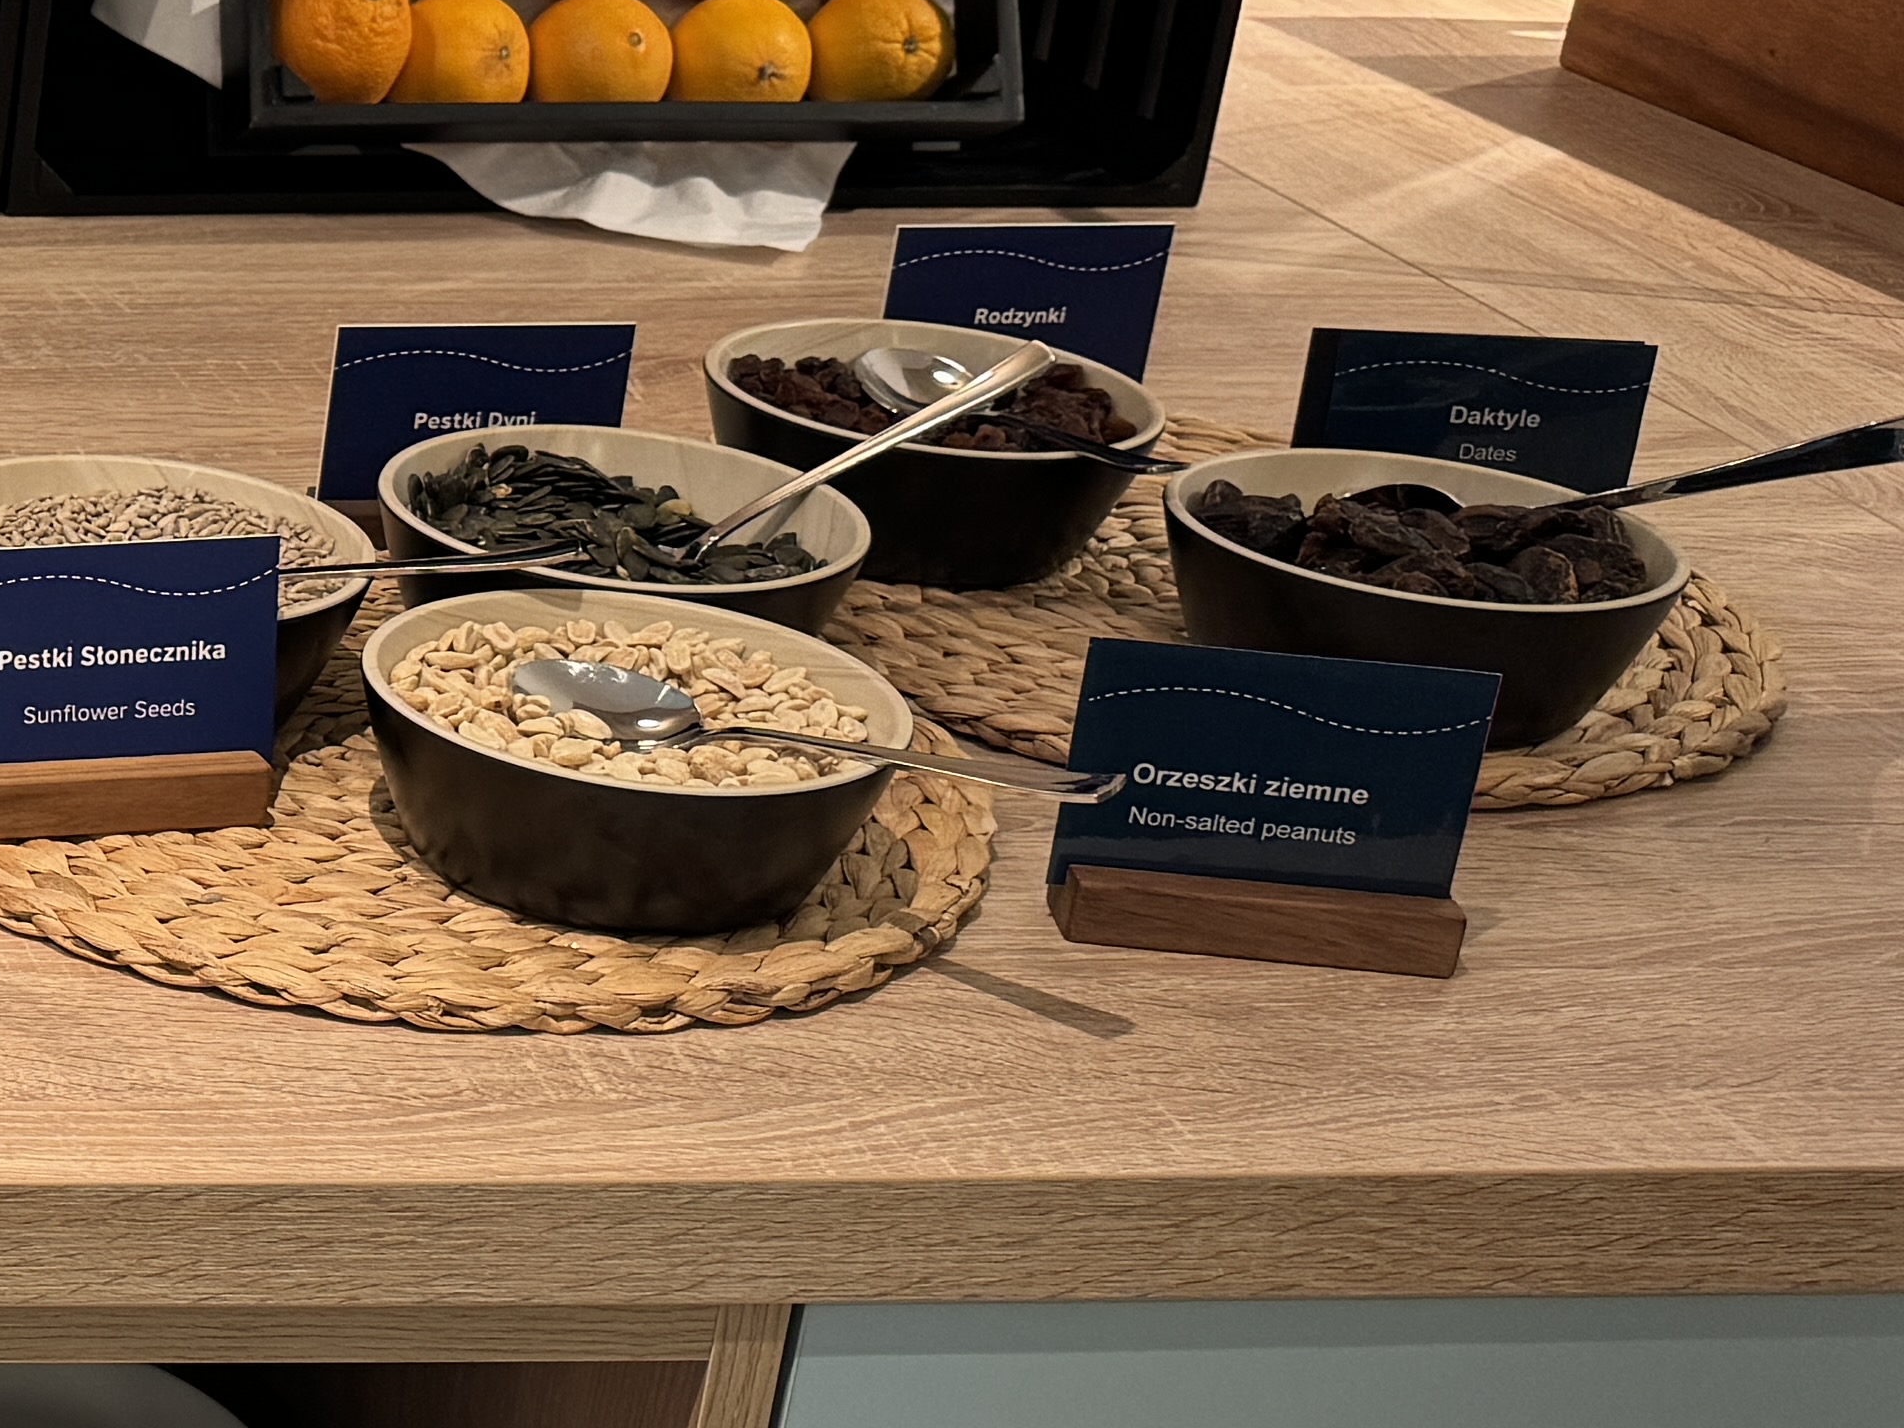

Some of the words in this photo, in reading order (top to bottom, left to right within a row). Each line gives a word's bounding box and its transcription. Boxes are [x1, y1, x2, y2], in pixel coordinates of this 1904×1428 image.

[974, 306, 1068, 328] Rodzynki
[413, 411, 482, 430] Pestki
[1449, 405, 1541, 431] Daktyle
[1459, 443, 1517, 462] Dates
[80, 640, 227, 667] Słonecznika
[23, 704, 128, 725] Sunflower
[134, 698, 196, 719] Seeds
[1132, 762, 1258, 795] Orzeszki
[1263, 776, 1370, 806] ziemne
[1128, 805, 1256, 835] Non-salted
[1260, 821, 1357, 845] peanuts
